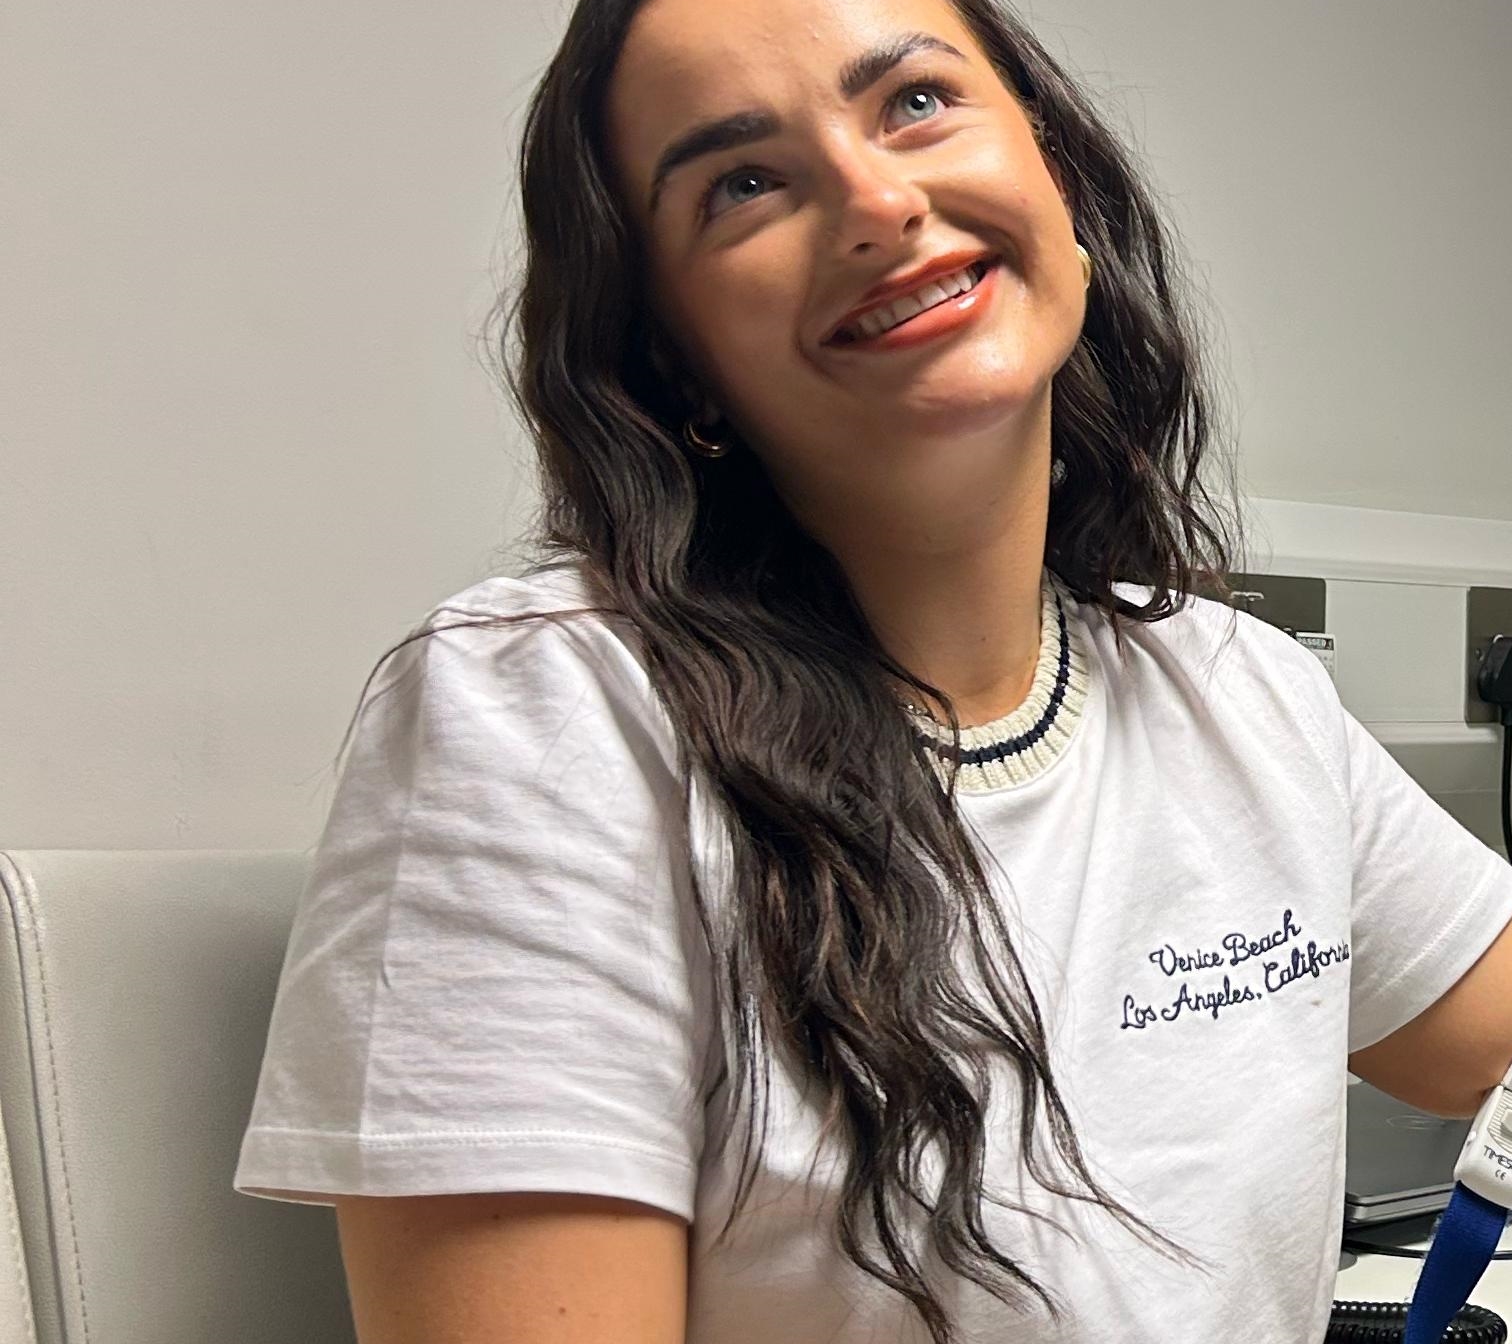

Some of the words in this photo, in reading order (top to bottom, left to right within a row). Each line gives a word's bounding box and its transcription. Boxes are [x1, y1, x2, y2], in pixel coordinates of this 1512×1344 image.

[1149, 944, 1224, 976] Venice
[1222, 909, 1302, 966] Beach
[1120, 994, 1158, 1030] Los
